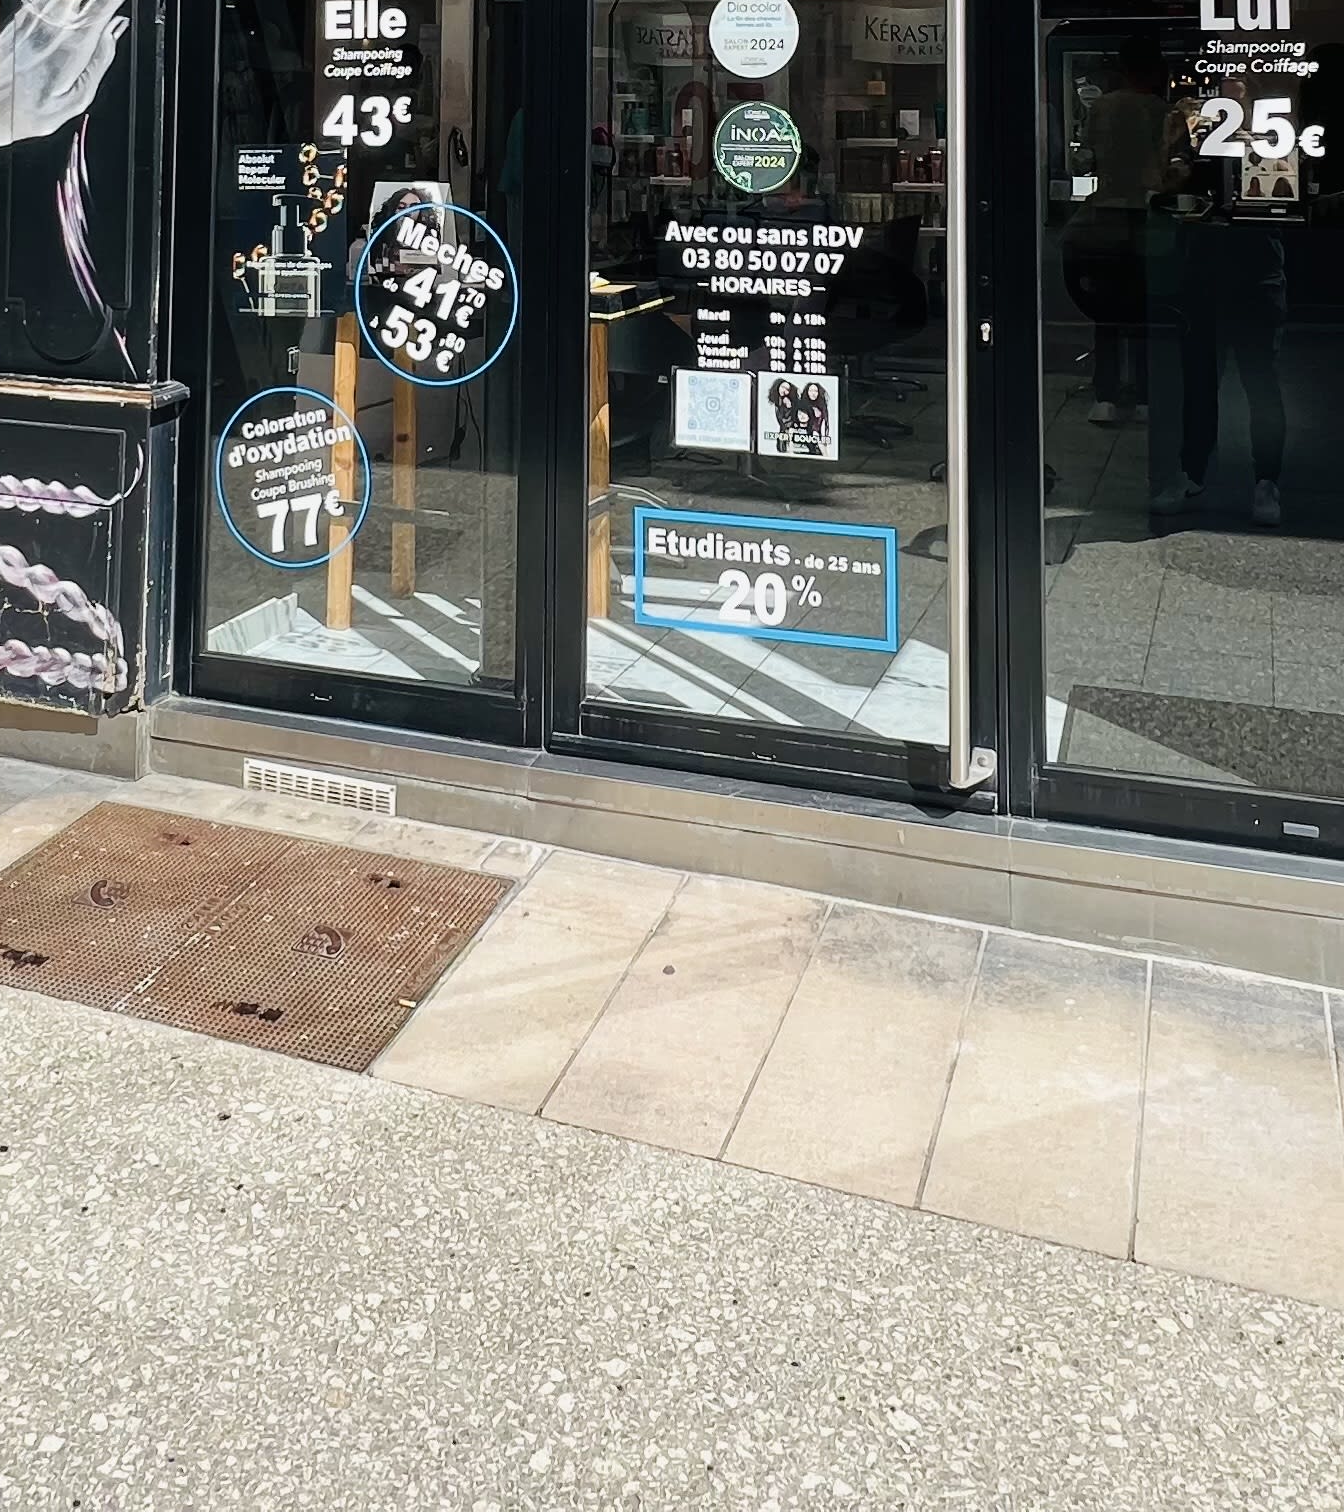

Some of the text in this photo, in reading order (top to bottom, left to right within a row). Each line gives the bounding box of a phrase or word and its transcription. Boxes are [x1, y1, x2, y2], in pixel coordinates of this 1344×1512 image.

[727, 1, 782, 13] Dia color
[864, 15, 944, 43] KÉRAST
[750, 38, 784, 50] 2024
[897, 44, 944, 55] PARIS
[1206, 40, 1306, 57] Shampooing
[333, 47, 403, 64] Shampooing
[324, 63, 412, 80] Coupe Coiffage
[1194, 58, 1320, 77] Coupe Coiffage
[322, 94, 412, 147] 43€
[1199, 97, 1326, 159] 25€
[754, 155, 785, 168] 2024
[664, 220, 864, 248] Avec ou sans RDV
[396, 216, 505, 290] Mèches
[682, 247, 845, 274] 03 80 50 07 07
[697, 308, 731, 322] Mardi
[697, 332, 729, 345] Jeudi
[764, 336, 786, 348] 10h
[697, 344, 748, 358] Vendredi
[698, 356, 741, 369] Samedi
[242, 408, 327, 439] Coloration
[228, 424, 352, 468] d'oxydation
[255, 458, 323, 483] Shampooing
[251, 473, 336, 501] Coupe Brushing
[257, 489, 345, 553] 77€
[647, 526, 792, 567] Etudiants
[804, 553, 824, 570] de
[828, 555, 849, 573] 25
[851, 561, 882, 575] ans
